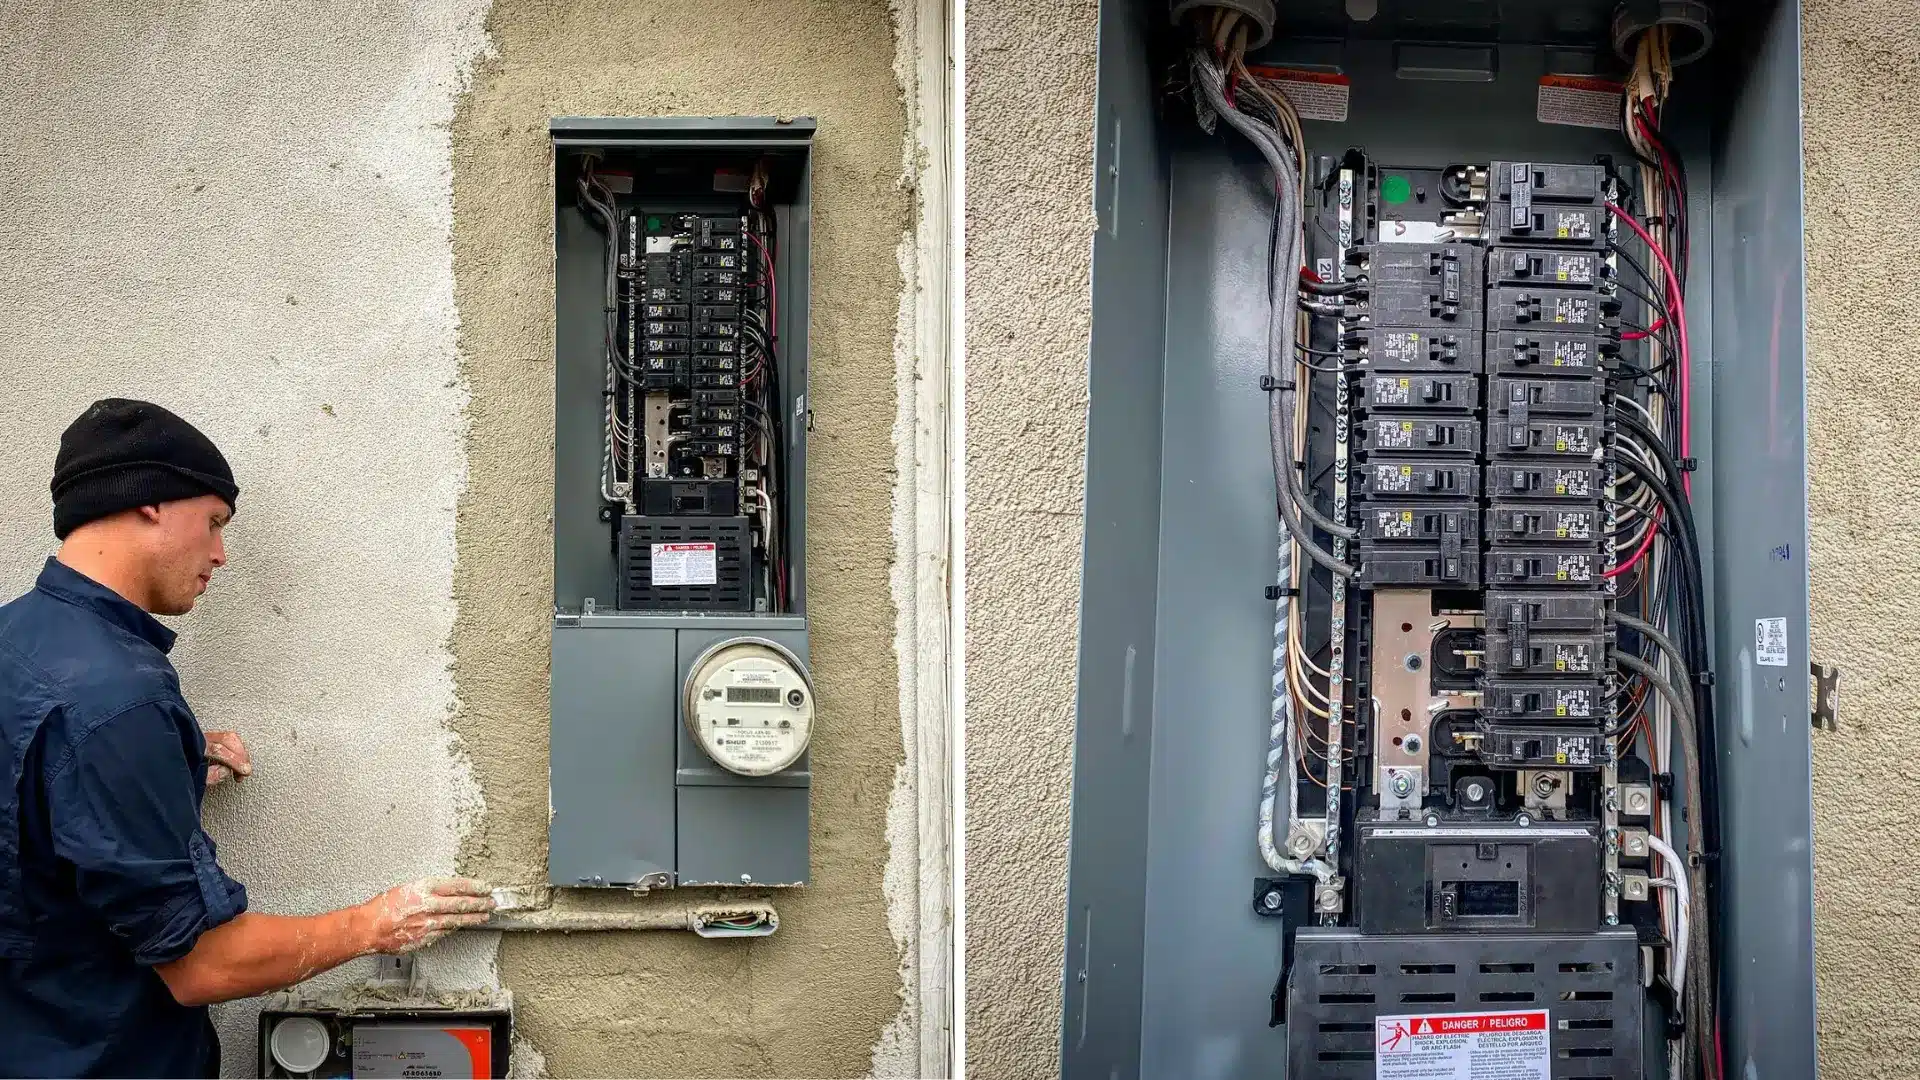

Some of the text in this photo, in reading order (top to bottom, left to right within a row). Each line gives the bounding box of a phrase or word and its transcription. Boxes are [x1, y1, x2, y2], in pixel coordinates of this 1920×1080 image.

[1320, 263, 1332, 280] 20
[1442, 1020, 1479, 1030] DANGER
[1490, 1018, 1528, 1028] PELIGRO
